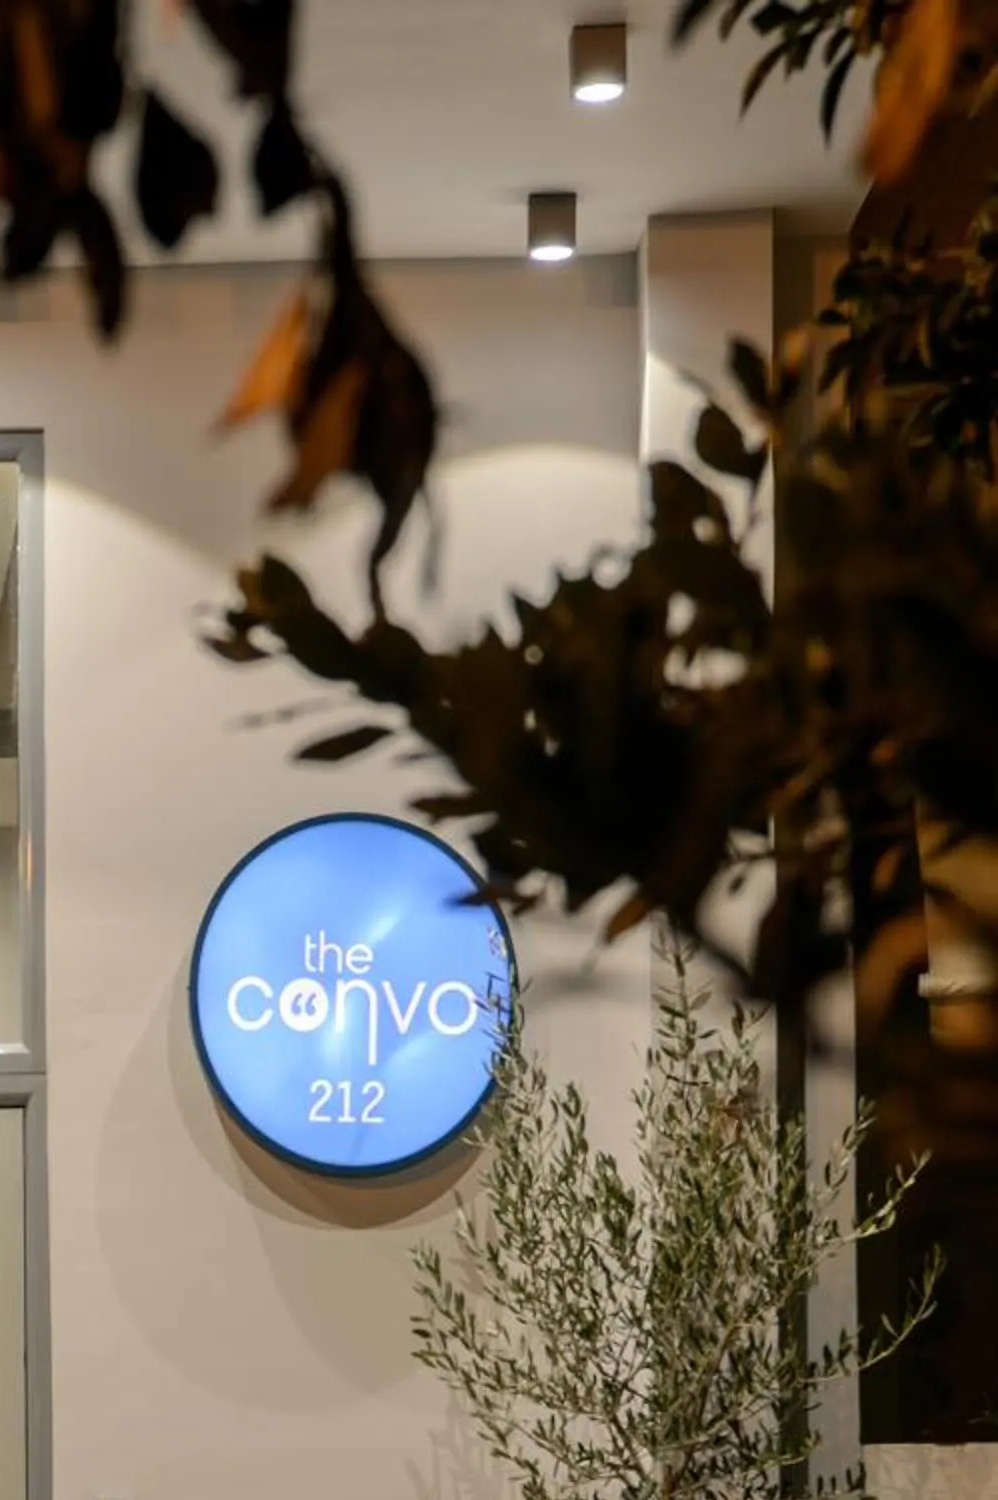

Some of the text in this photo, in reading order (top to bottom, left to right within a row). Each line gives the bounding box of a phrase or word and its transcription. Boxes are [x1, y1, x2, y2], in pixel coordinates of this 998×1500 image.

[304, 929, 374, 974] the
[227, 976, 479, 1065] convo
[308, 1079, 385, 1124] 212
